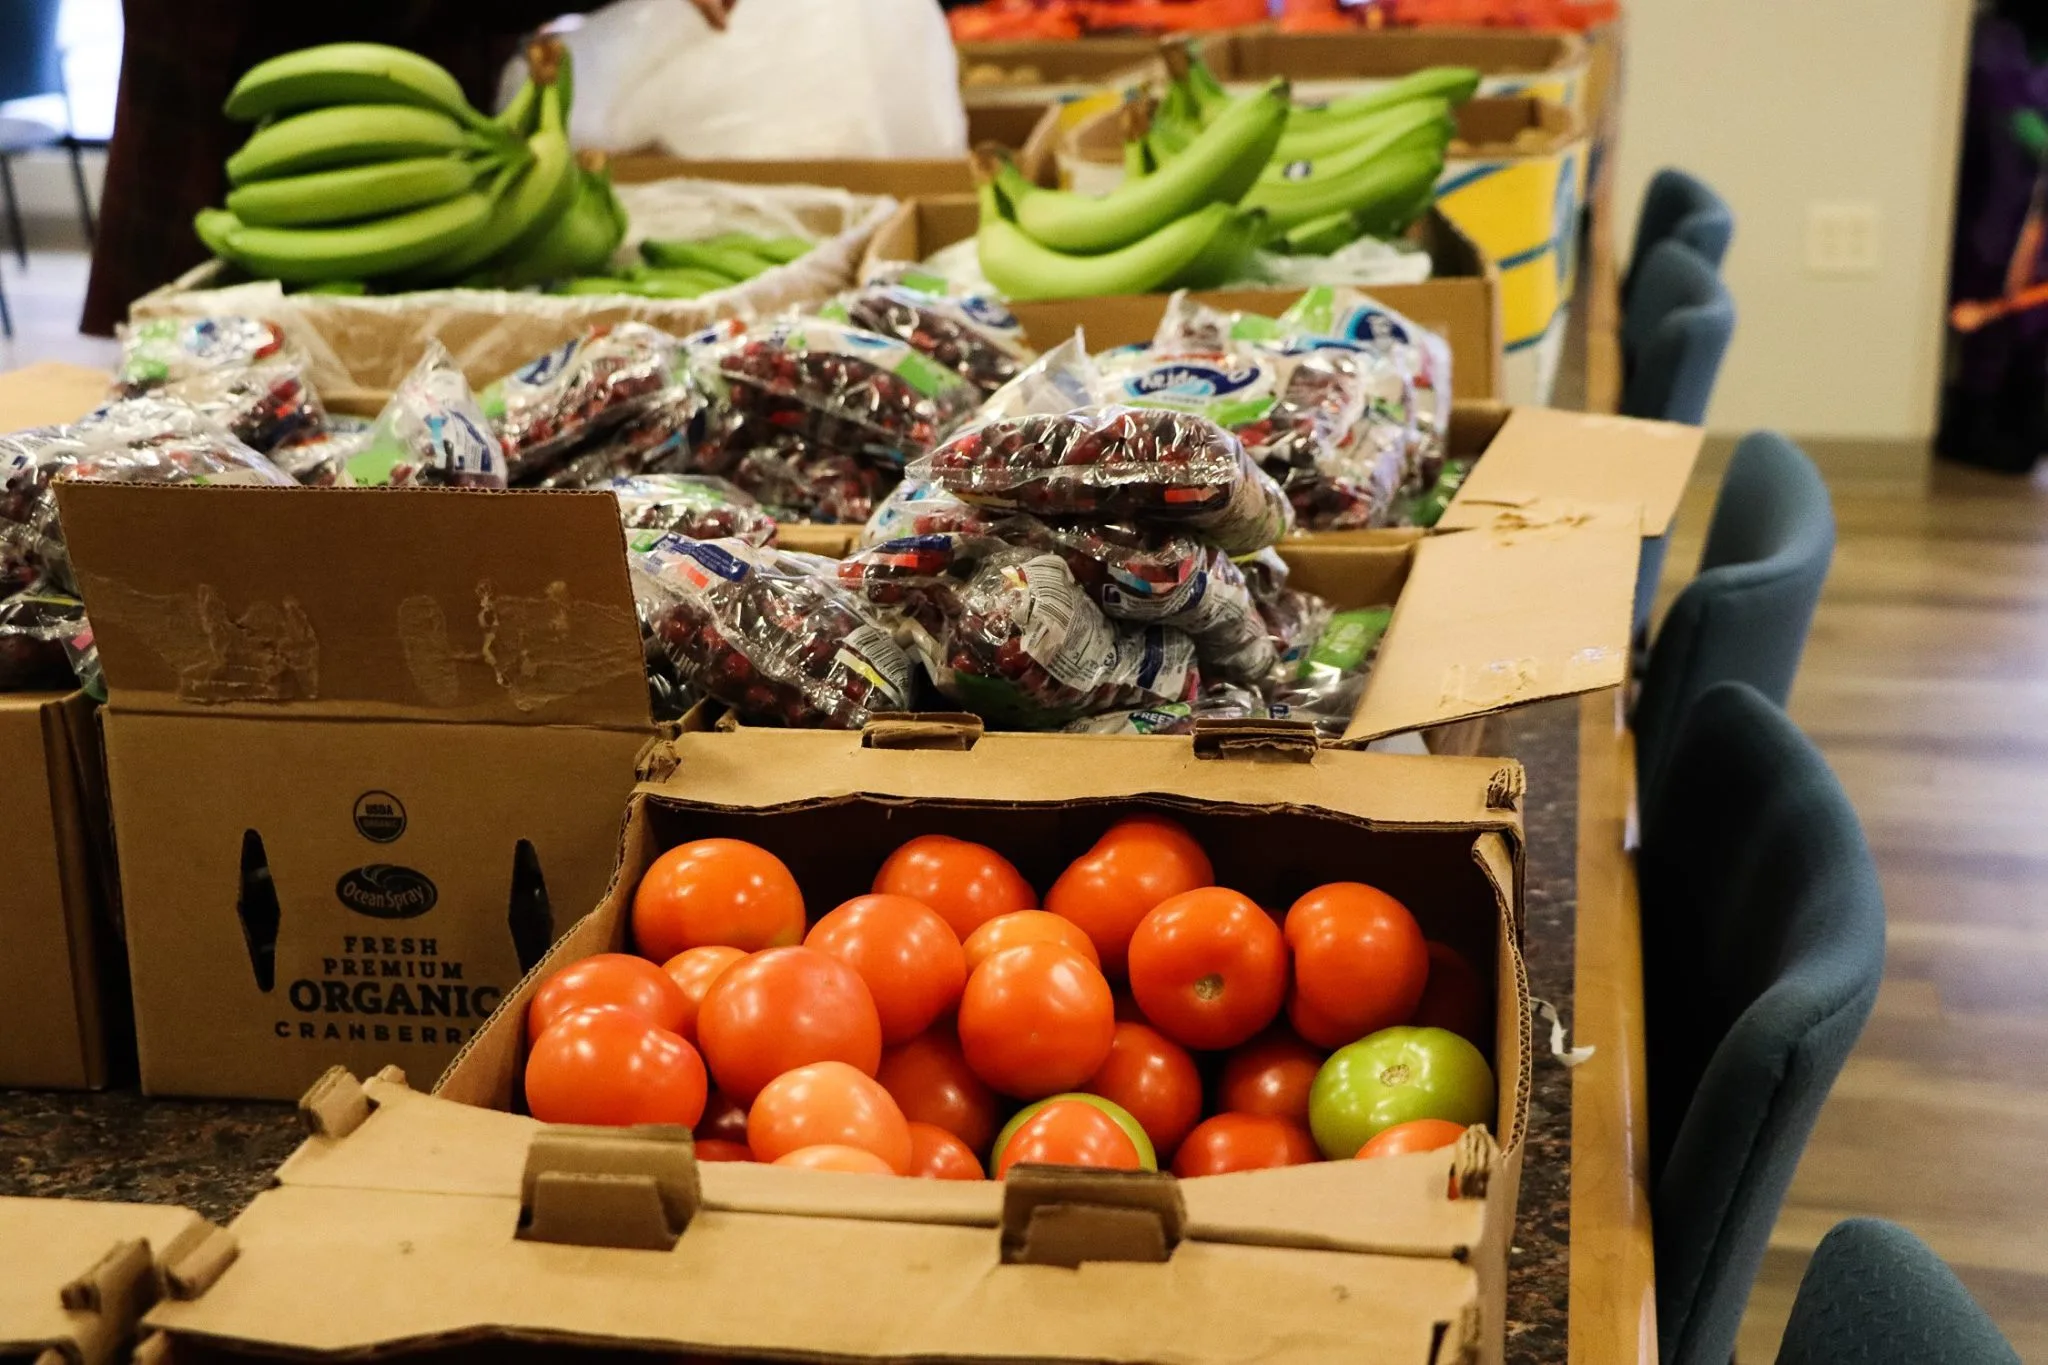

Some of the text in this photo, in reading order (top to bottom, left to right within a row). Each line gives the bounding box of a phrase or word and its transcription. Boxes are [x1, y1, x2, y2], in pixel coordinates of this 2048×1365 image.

[343, 880, 424, 912] Ocean Spray
[344, 937, 437, 955] FRESH
[323, 958, 462, 979] PREMIUM
[289, 980, 500, 1018] ORGANIC
[275, 1022, 476, 1044] CRANBERR
